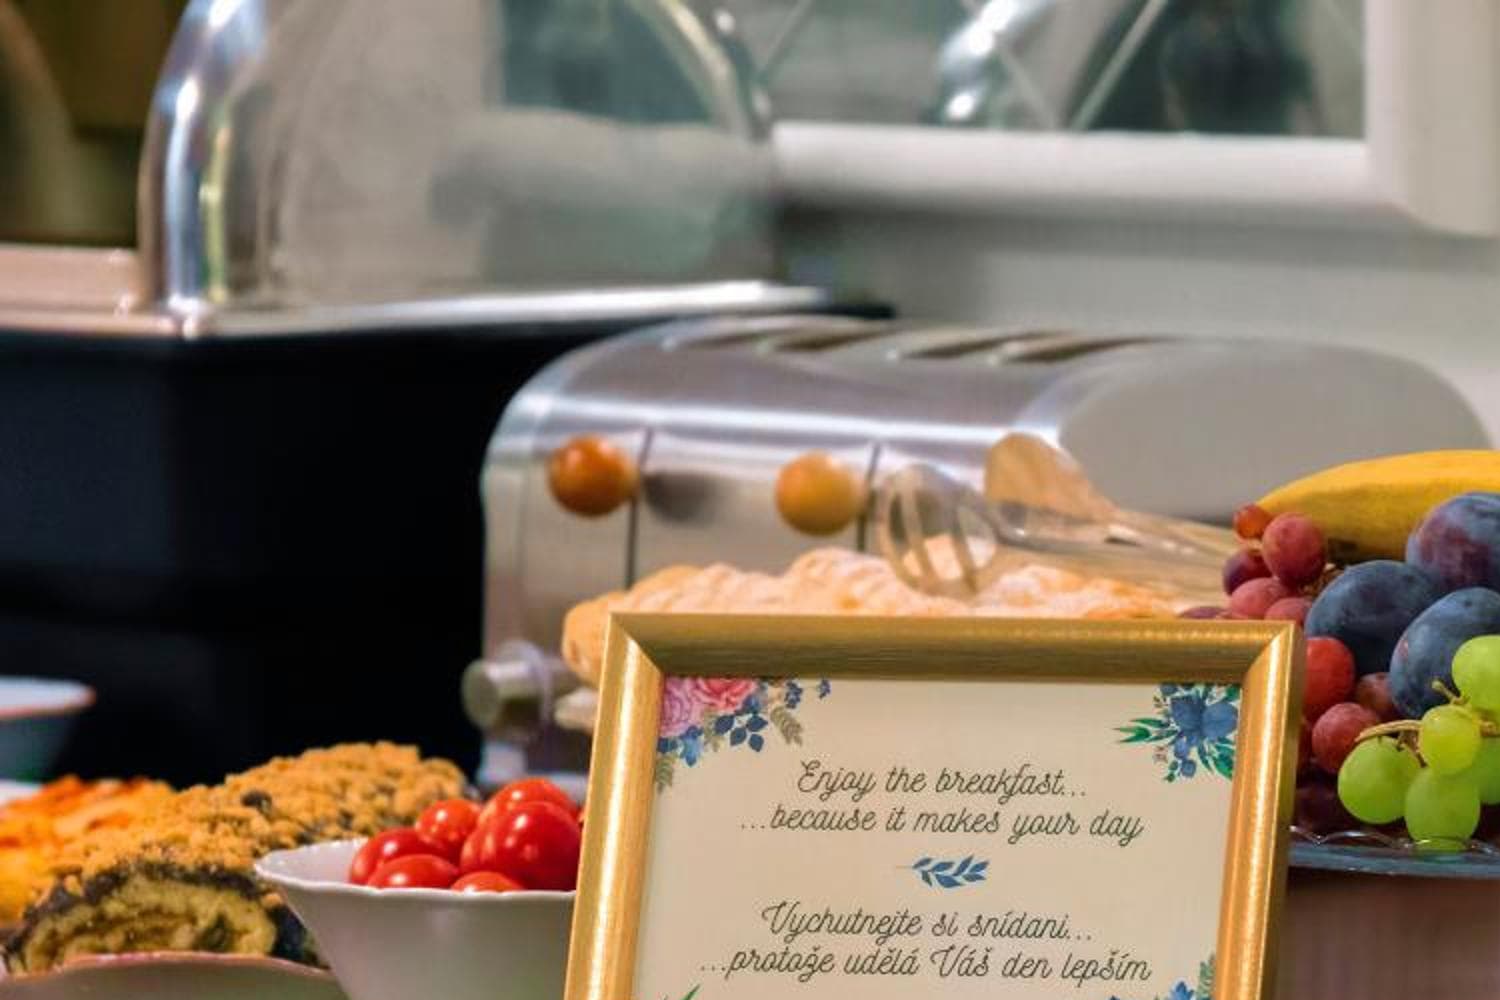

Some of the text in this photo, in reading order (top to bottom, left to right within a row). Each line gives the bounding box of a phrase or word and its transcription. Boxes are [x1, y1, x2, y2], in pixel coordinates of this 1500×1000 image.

[797, 760, 877, 802] Enjoy
[885, 766, 927, 793] the
[885, 805, 906, 832] it
[913, 807, 1000, 834] makes
[1007, 811, 1080, 845] your
[1089, 808, 1145, 848] day
[761, 900, 923, 946] Vychutnejte
[931, 911, 958, 937] si
[843, 948, 920, 976] udělá
[930, 943, 993, 978] Váš
[1001, 951, 1054, 979] den
[1060, 949, 1153, 989] lepším
